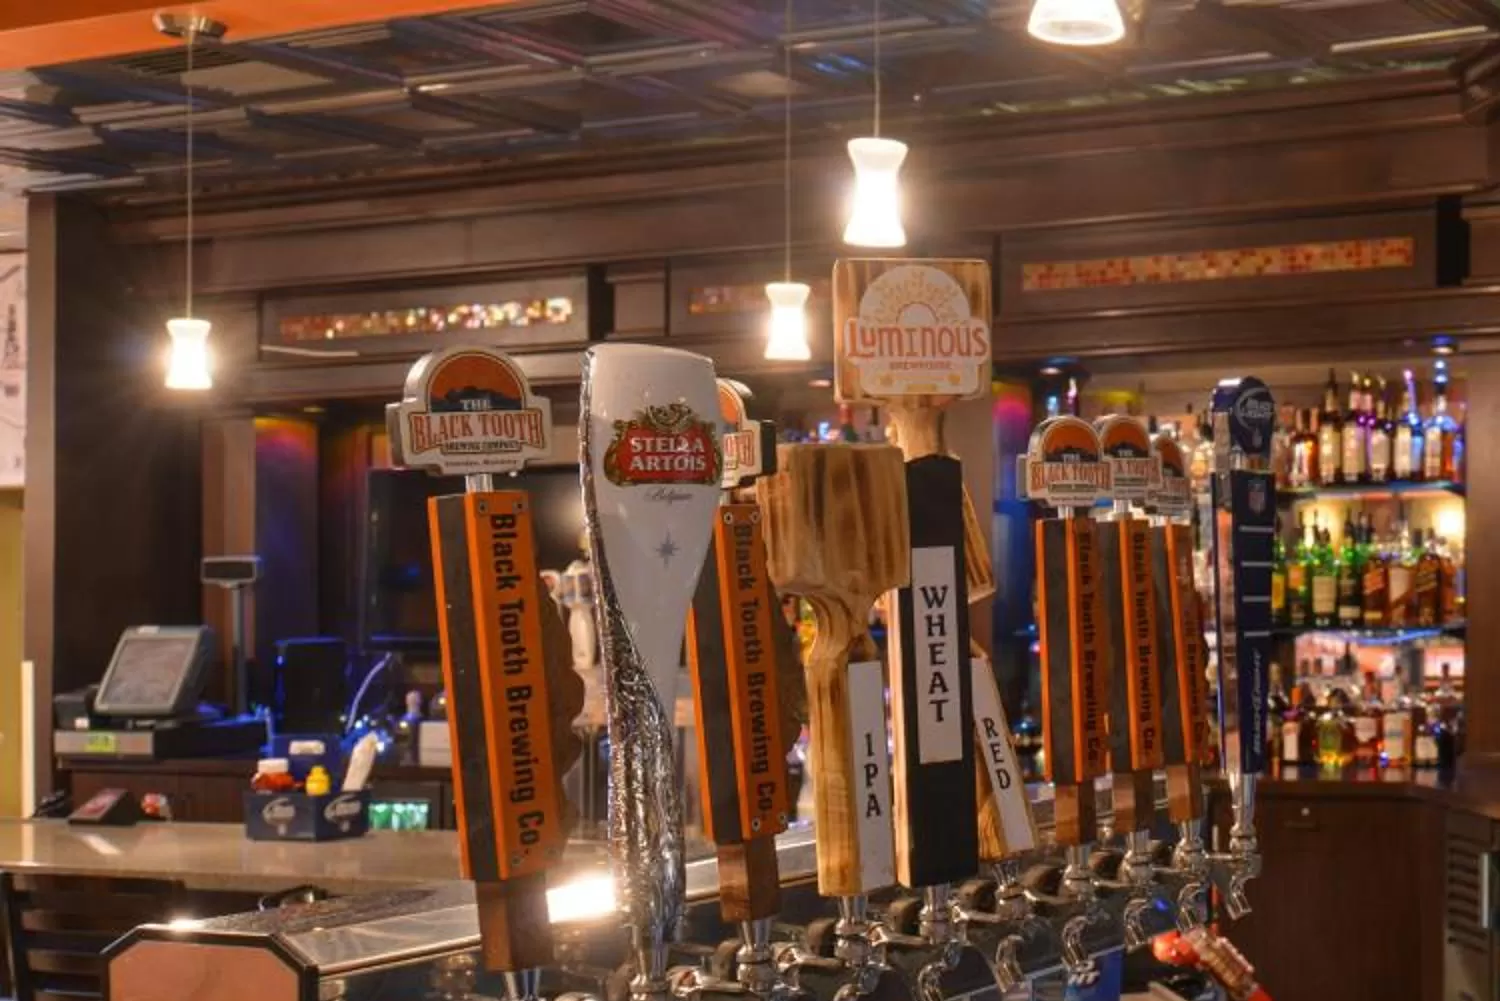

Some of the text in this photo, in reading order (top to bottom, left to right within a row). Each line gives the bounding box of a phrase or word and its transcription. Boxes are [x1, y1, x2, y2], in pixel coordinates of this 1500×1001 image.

[413, 412, 542, 450] BLACK TOOTH
[628, 453, 707, 472] ARTOIS
[629, 436, 706, 454] STELLA
[489, 512, 545, 856] Black Tooth Brewing Co.
[733, 524, 776, 818] Black Tooth Brewing Co.
[919, 585, 950, 724] WHEAT
[1138, 644, 1154, 723] Brewing
[863, 732, 883, 819] IPA
[982, 715, 1012, 791] RED
